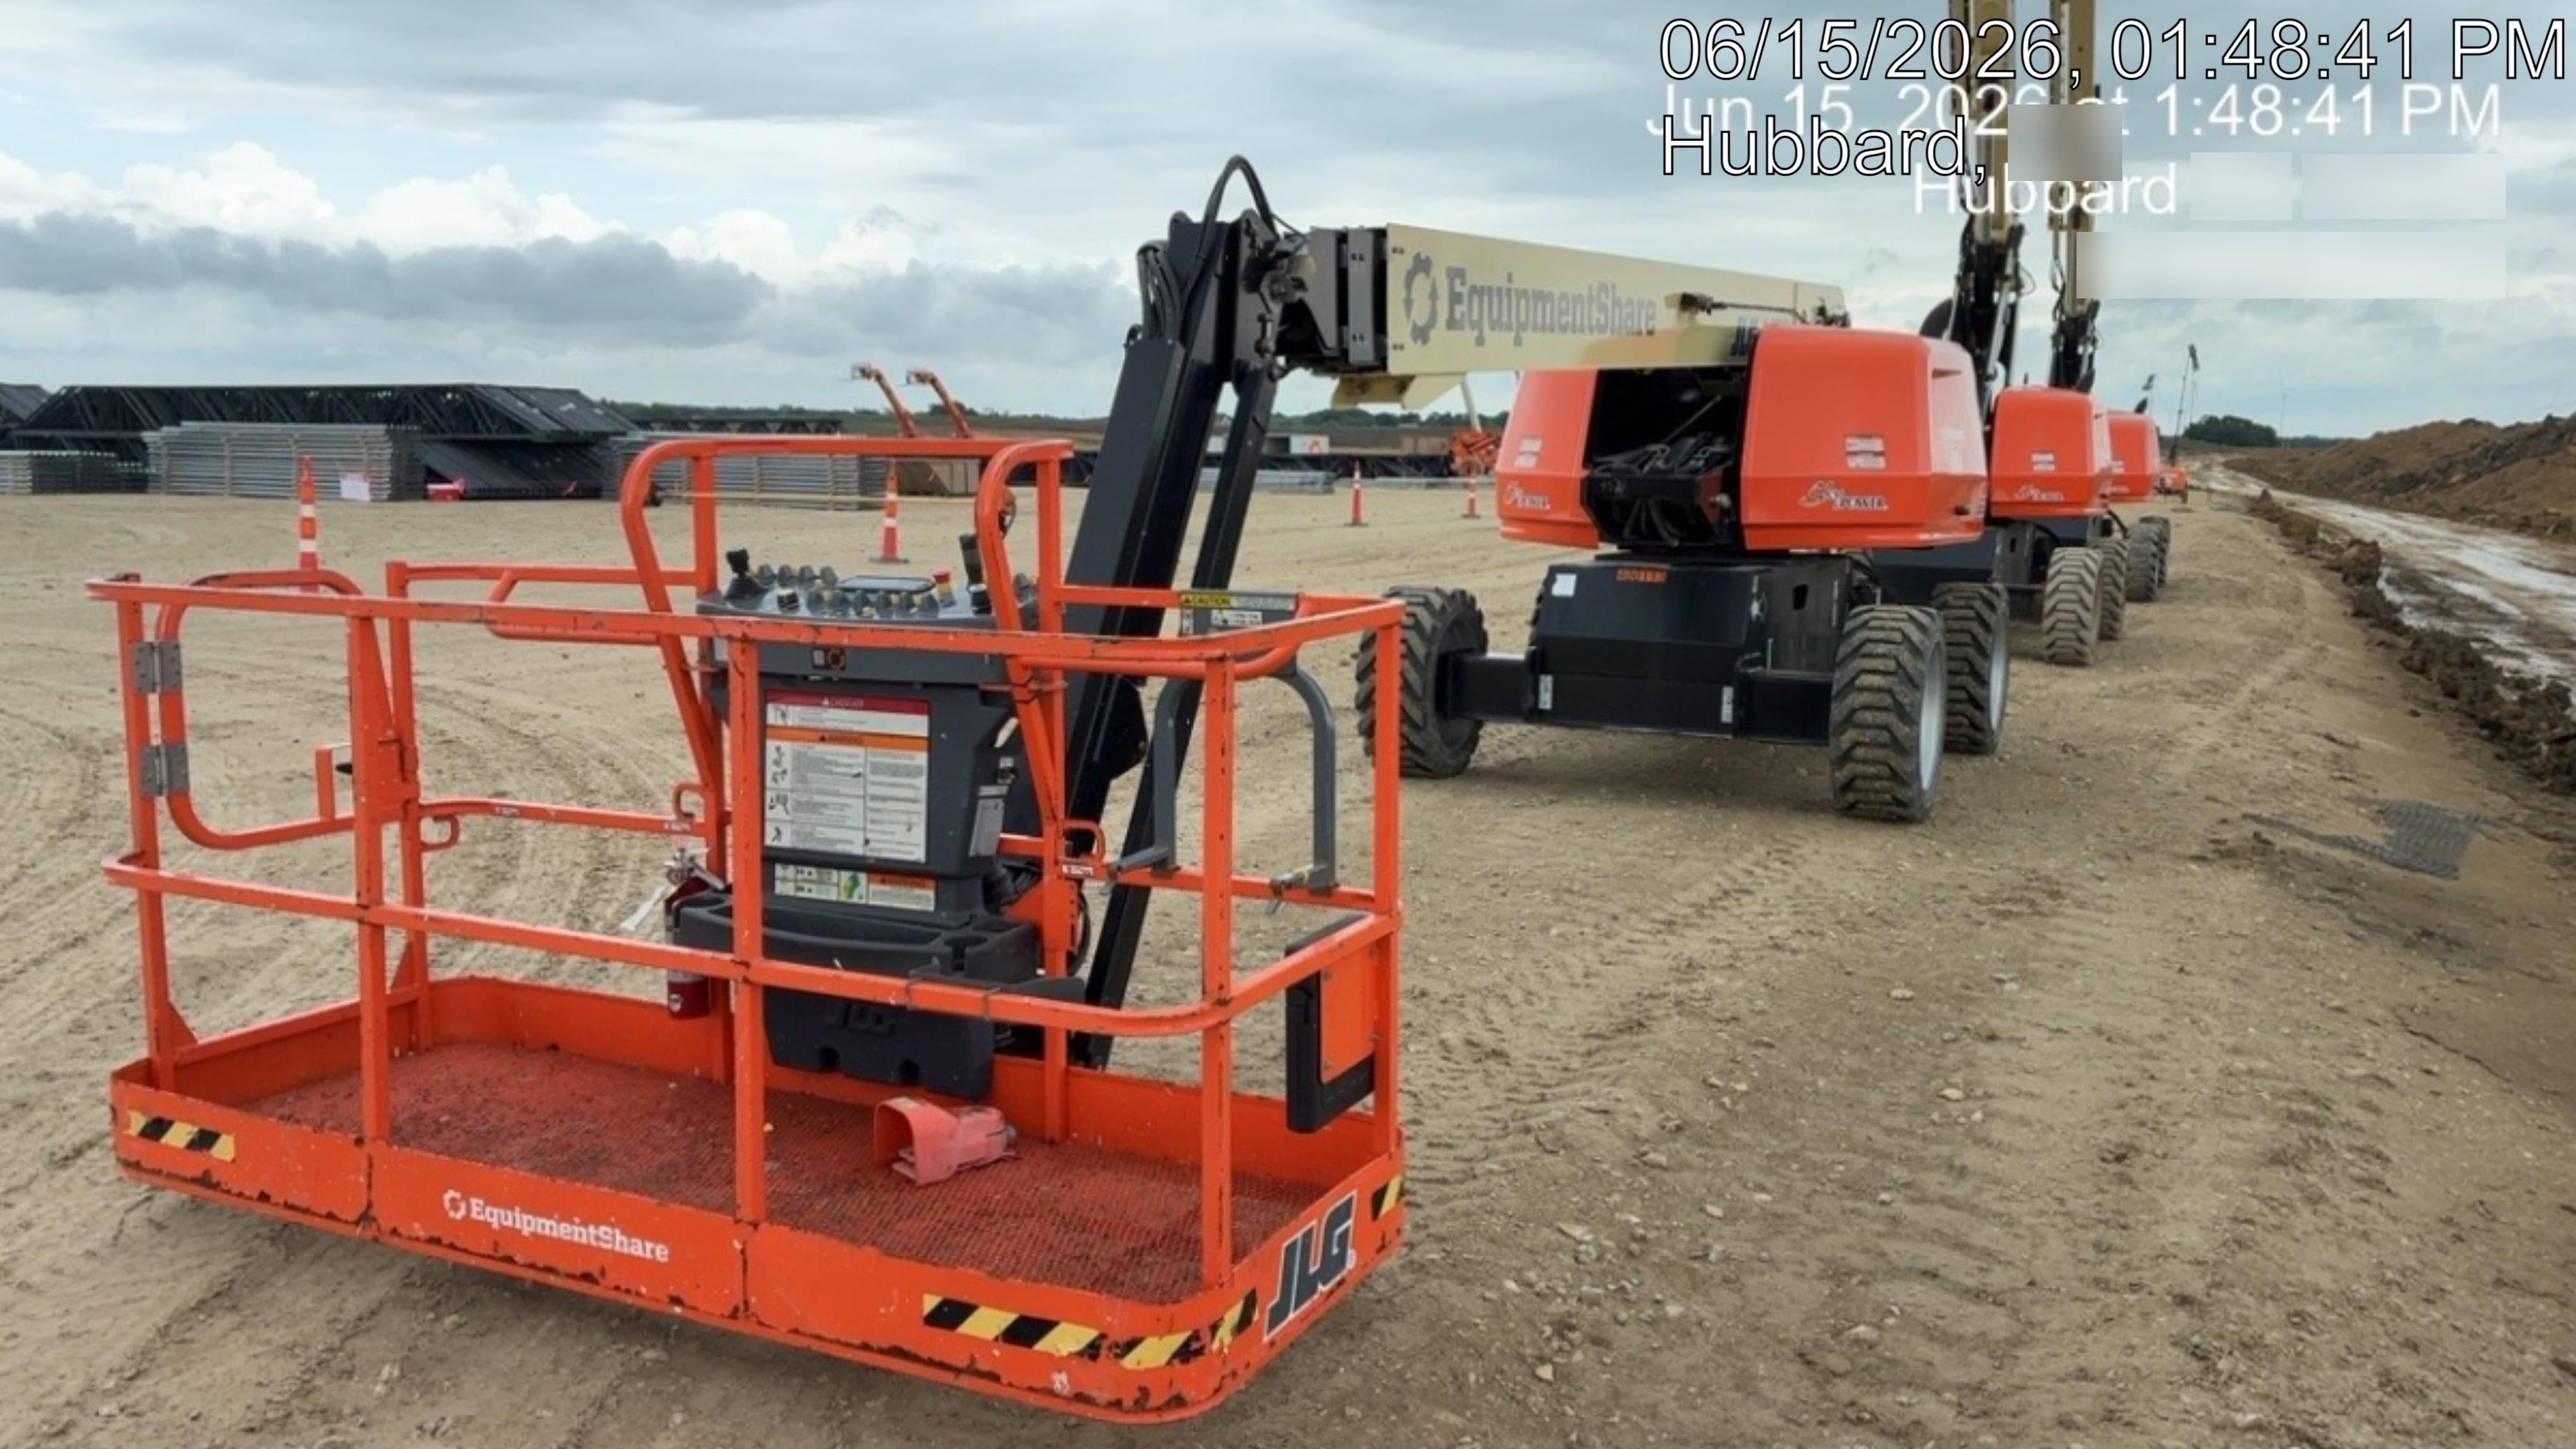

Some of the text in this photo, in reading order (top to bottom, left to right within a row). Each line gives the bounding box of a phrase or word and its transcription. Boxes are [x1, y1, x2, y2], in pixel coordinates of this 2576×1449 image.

[1445, 265, 1657, 346] EquipmentShare
[469, 1197, 670, 1263] EquipmentShare
[1262, 1189, 1357, 1343] JLG
